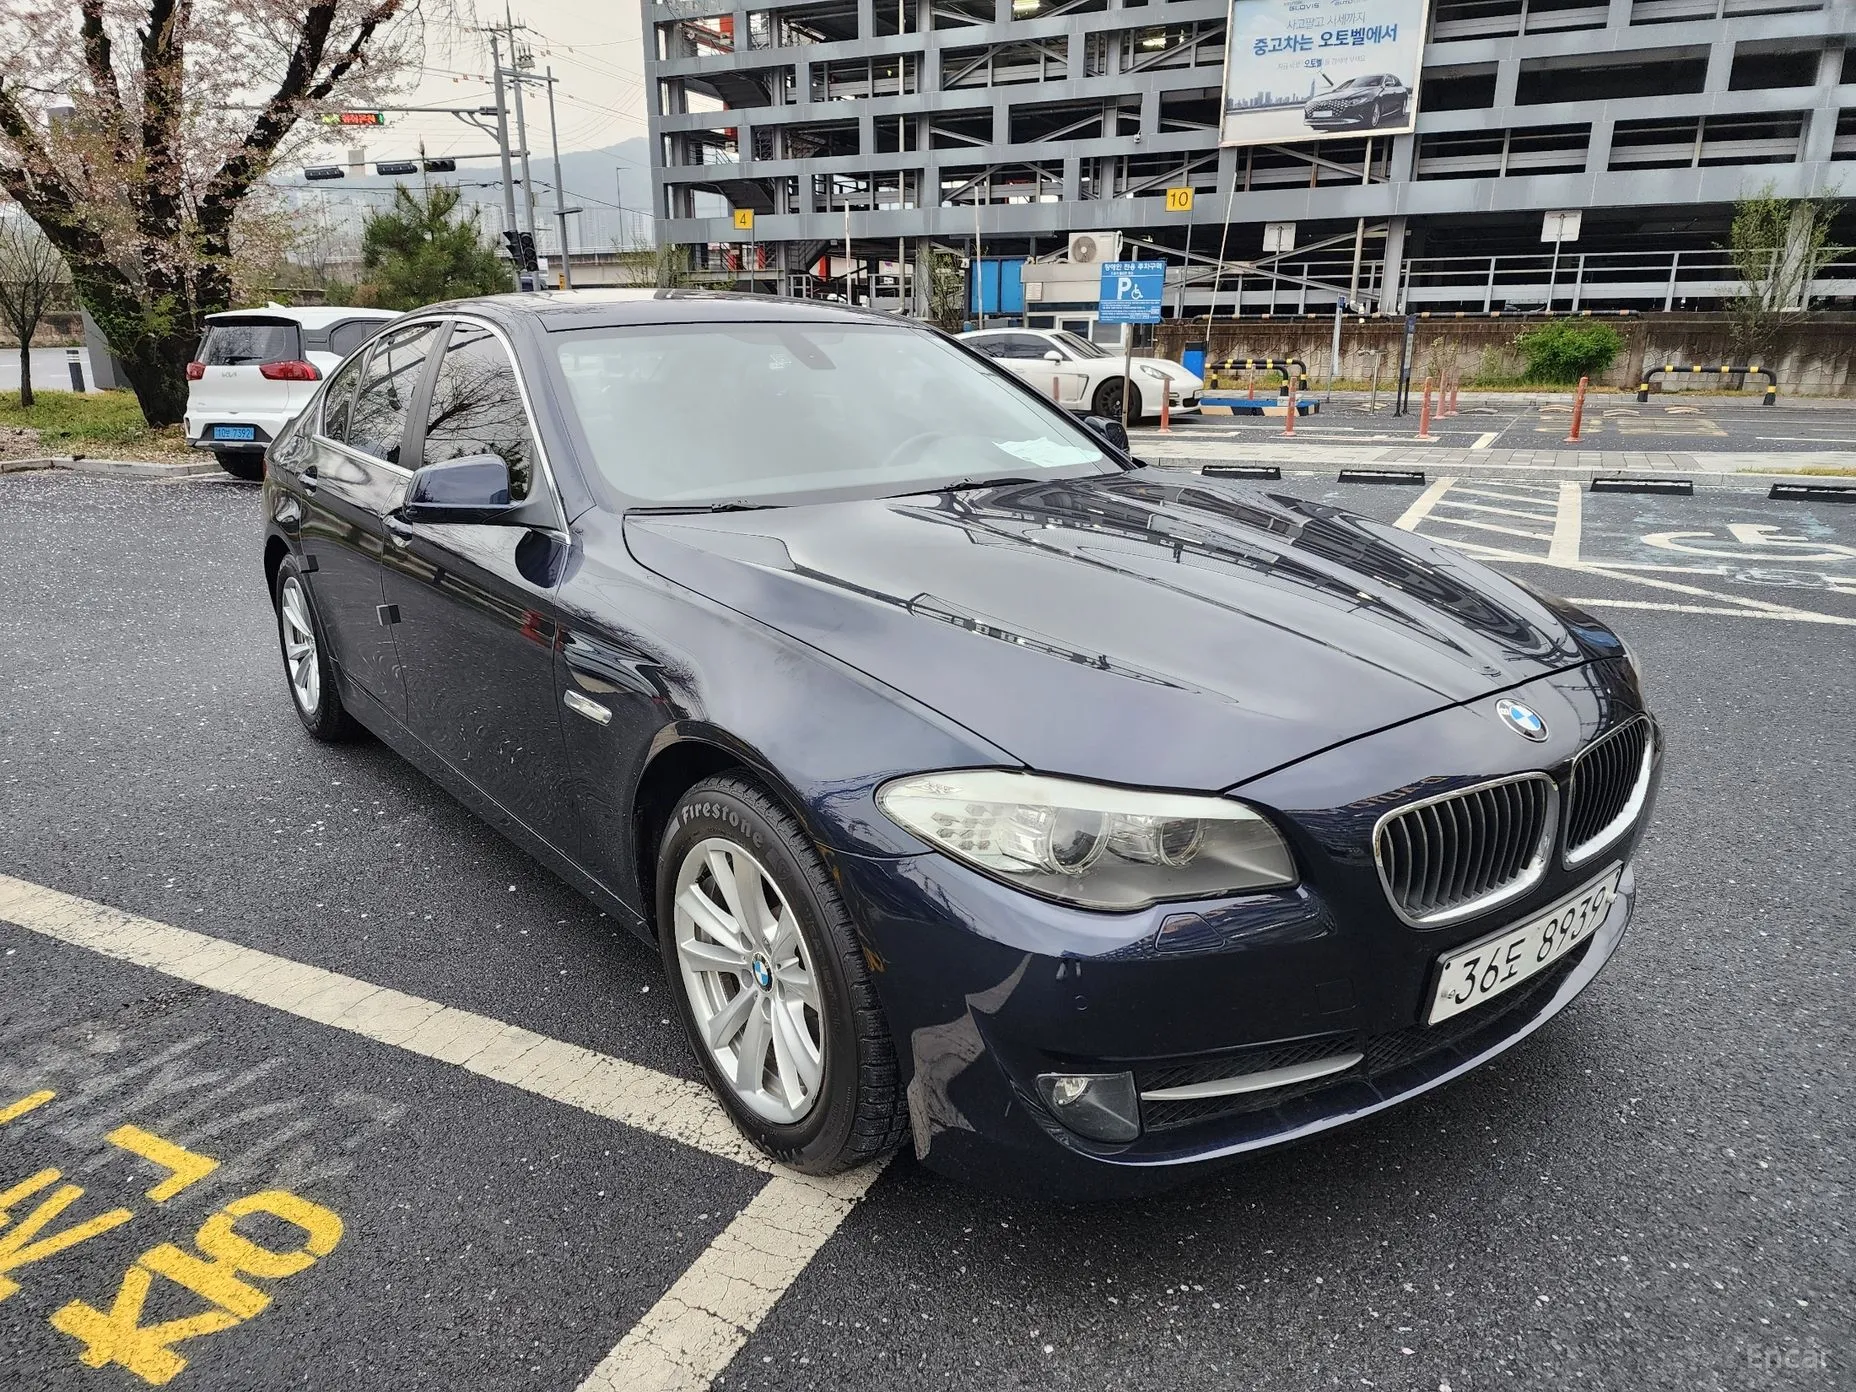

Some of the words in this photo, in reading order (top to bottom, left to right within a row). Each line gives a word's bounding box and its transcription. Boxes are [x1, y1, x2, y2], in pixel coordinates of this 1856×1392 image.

[1289, 2, 1320, 12] GLOVIS
[1253, 34, 1314, 56] 중고차는
[1318, 23, 1398, 48] 오토벨에서
[1170, 191, 1189, 207] 10
[739, 212, 746, 226] 4
[1116, 277, 1132, 300] P
[232, 428, 251, 439] 7392
[681, 800, 764, 849] Firestone
[1455, 937, 1526, 1005] 36도
[1536, 886, 1607, 963] 8939
